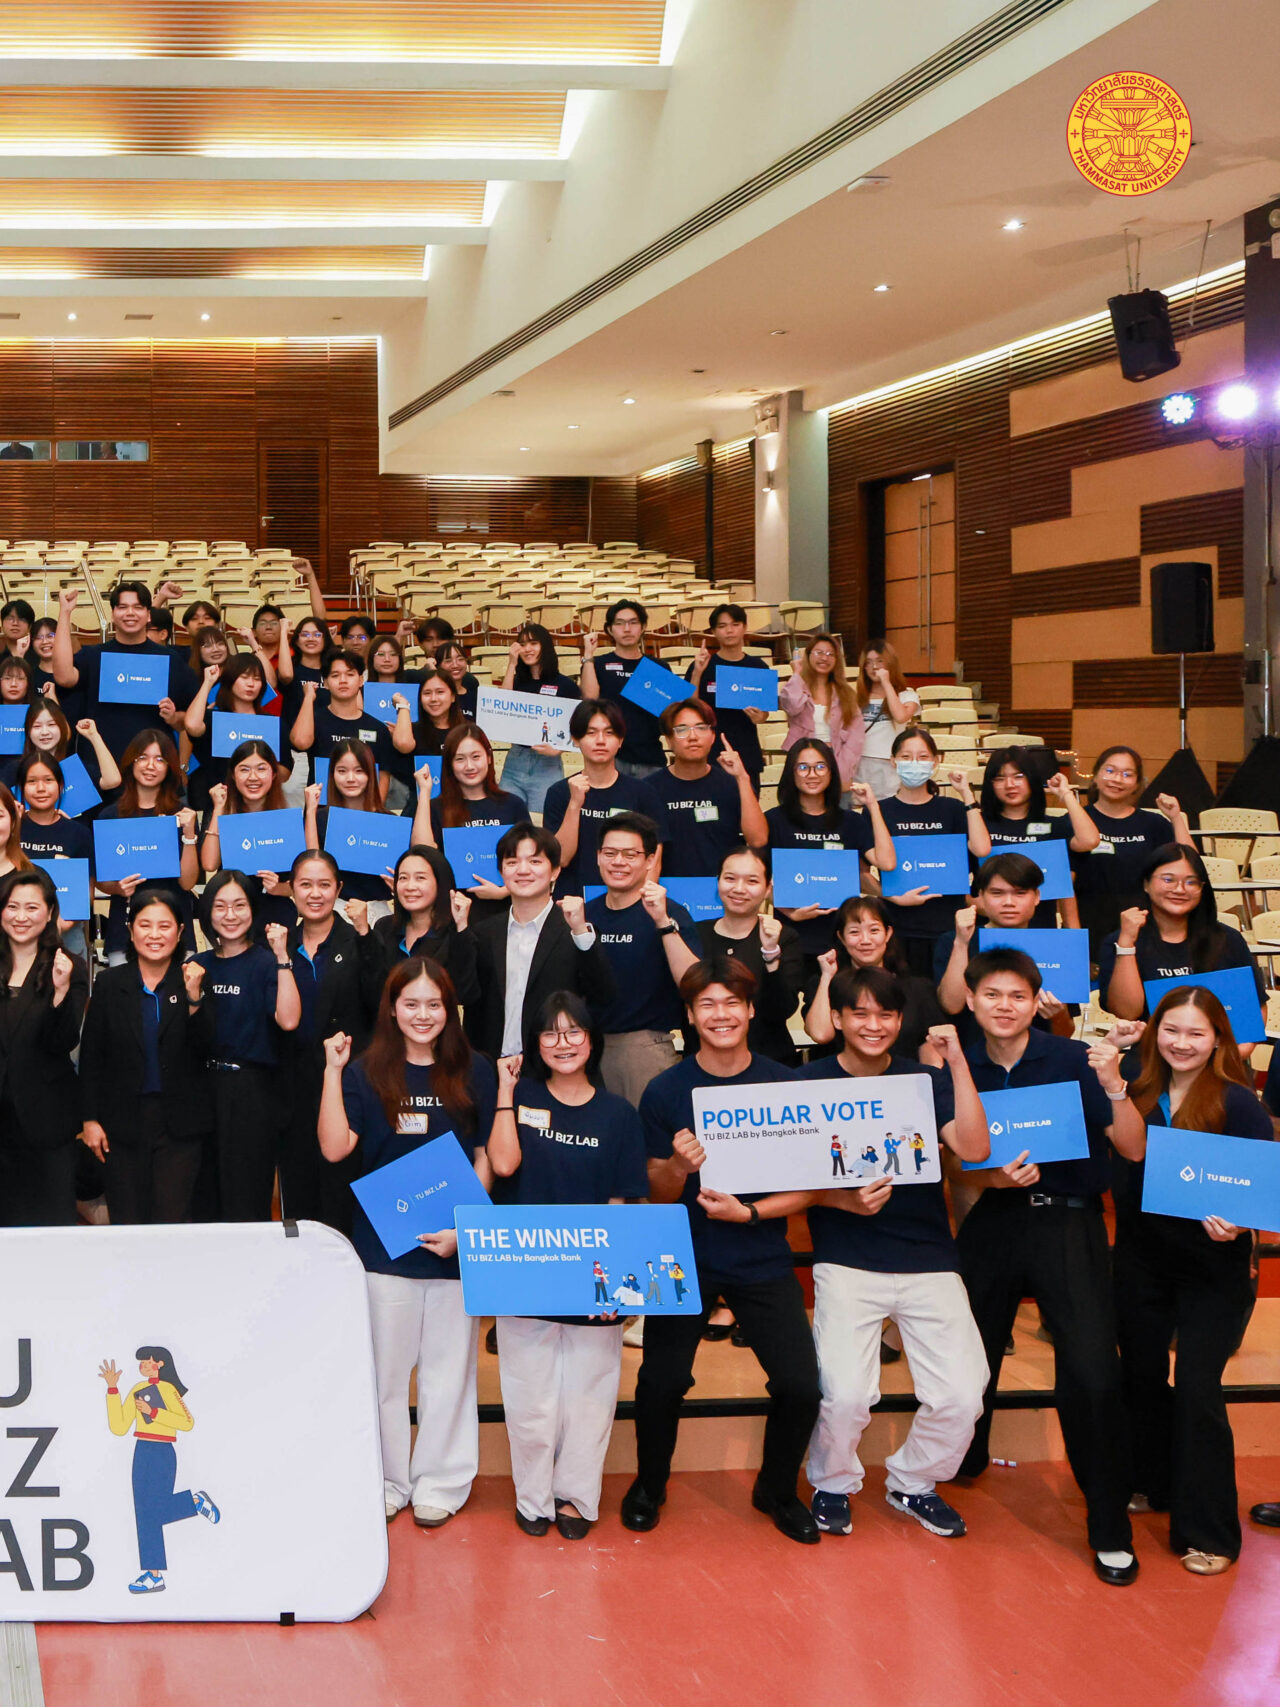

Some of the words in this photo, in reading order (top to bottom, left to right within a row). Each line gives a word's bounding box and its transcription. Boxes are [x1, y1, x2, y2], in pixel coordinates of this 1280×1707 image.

[482, 697, 492, 707] 1st
[494, 699, 563, 718] RUNNER-UP
[667, 802, 679, 810] TU
[680, 801, 694, 809] BIZ
[694, 800, 712, 808] LAB
[581, 808, 591, 816] TU
[593, 810, 604, 818] BIZ
[794, 832, 806, 840] TU
[808, 833, 820, 841] BIZ
[822, 832, 840, 840] LAB
[990, 833, 1002, 842] TU
[1004, 835, 1018, 843] BIZ
[1099, 833, 1110, 841] TU
[1111, 835, 1126, 843] BIZ
[1127, 834, 1145, 843] LAB
[47, 843, 63, 852] LAB
[601, 934, 614, 943] BIZ
[616, 934, 632, 943] LAB
[1157, 968, 1172, 977] TU
[222, 985, 240, 995] LAB
[415, 1095, 434, 1107] BIZ
[702, 1104, 811, 1130] POPULAR
[821, 1100, 884, 1122] VOTE
[538, 1126, 554, 1139] TU
[555, 1131, 574, 1145] BIZ
[575, 1135, 599, 1147] LAB
[703, 1133, 715, 1141] TU
[732, 1131, 749, 1139] LAB
[750, 1130, 760, 1139] by
[762, 1128, 797, 1138] Bangkok
[799, 1126, 820, 1135] Bank
[1206, 1173, 1218, 1181] TU
[1219, 1174, 1233, 1184] BIZ
[1233, 1176, 1251, 1186] LAB
[415, 1193, 424, 1201] TU
[423, 1187, 435, 1197] BIZ
[434, 1181, 448, 1192] LAB
[464, 1228, 510, 1249] THE
[514, 1228, 610, 1248] WINNER
[466, 1254, 478, 1262] TU
[479, 1254, 494, 1262] BIZ
[495, 1254, 512, 1262] LAB
[512, 1254, 522, 1263] by
[524, 1254, 559, 1263] Bangkok
[560, 1254, 582, 1262] Bank
